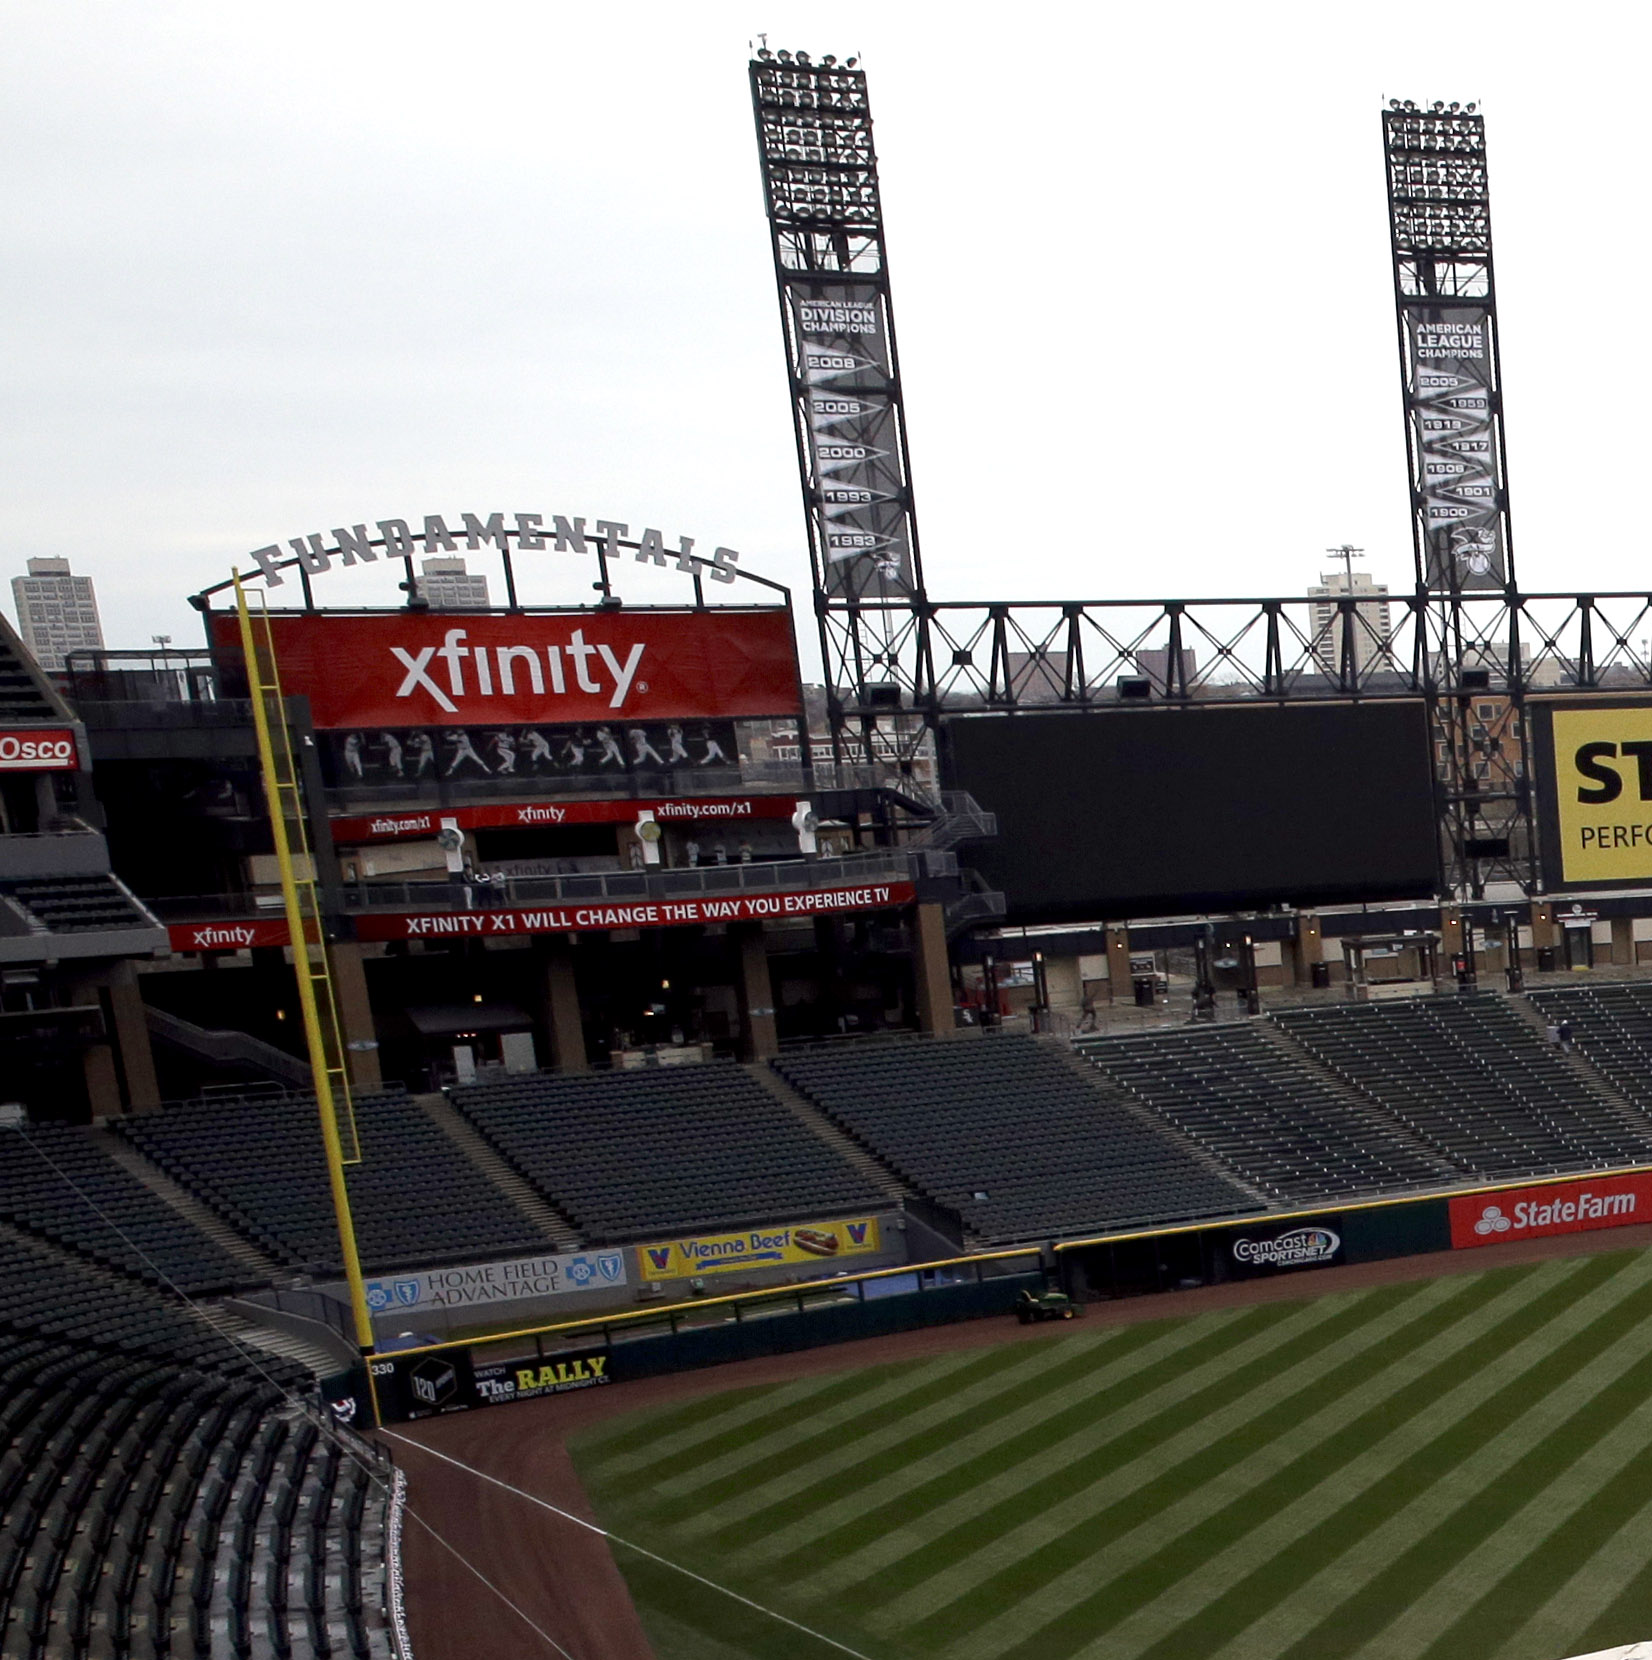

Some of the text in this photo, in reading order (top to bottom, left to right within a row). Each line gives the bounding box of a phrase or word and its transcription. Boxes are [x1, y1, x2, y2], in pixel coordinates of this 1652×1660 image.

[800, 308, 875, 323] DIVISION
[802, 322, 876, 334] CHAMPIONS
[1417, 324, 1482, 334] AMERICAN
[1418, 335, 1482, 348] LEAGUE
[1418, 349, 1483, 358] CHAMPIONS
[813, 401, 860, 413] 2005
[818, 447, 865, 458] 2000
[826, 491, 871, 502] 1993
[250, 512, 739, 587] FUNDAMENTALS
[389, 628, 645, 712] xfinity
[0, 737, 72, 759] Osco
[518, 807, 565, 824] xfinity
[657, 801, 752, 819] xfinity.com/x1
[370, 816, 431, 834] xfinity.com/x1
[406, 887, 890, 934] XFINITY X1 WILL CHANGE THE WAY YOU EXPERIENCE TV
[193, 926, 255, 947] xfinity
[680, 1239, 745, 1259] Vienna
[750, 1231, 792, 1250] Beef
[1233, 1234, 1307, 1261] Comcast
[1253, 1245, 1326, 1264] SPORTSNET
[428, 1259, 558, 1290] HOME FIELD
[432, 1276, 560, 1308] ADVANTAGE
[371, 1362, 395, 1376] 330
[474, 1367, 506, 1379] WATCH
[476, 1379, 514, 1397] The
[516, 1357, 606, 1390] RALLY
[413, 1376, 436, 1401] 120
[489, 1391, 515, 1403] EVERY
[517, 1388, 543, 1399] NIGHT
[544, 1386, 554, 1394] AT
[556, 1378, 596, 1392] MIDNIGHT
